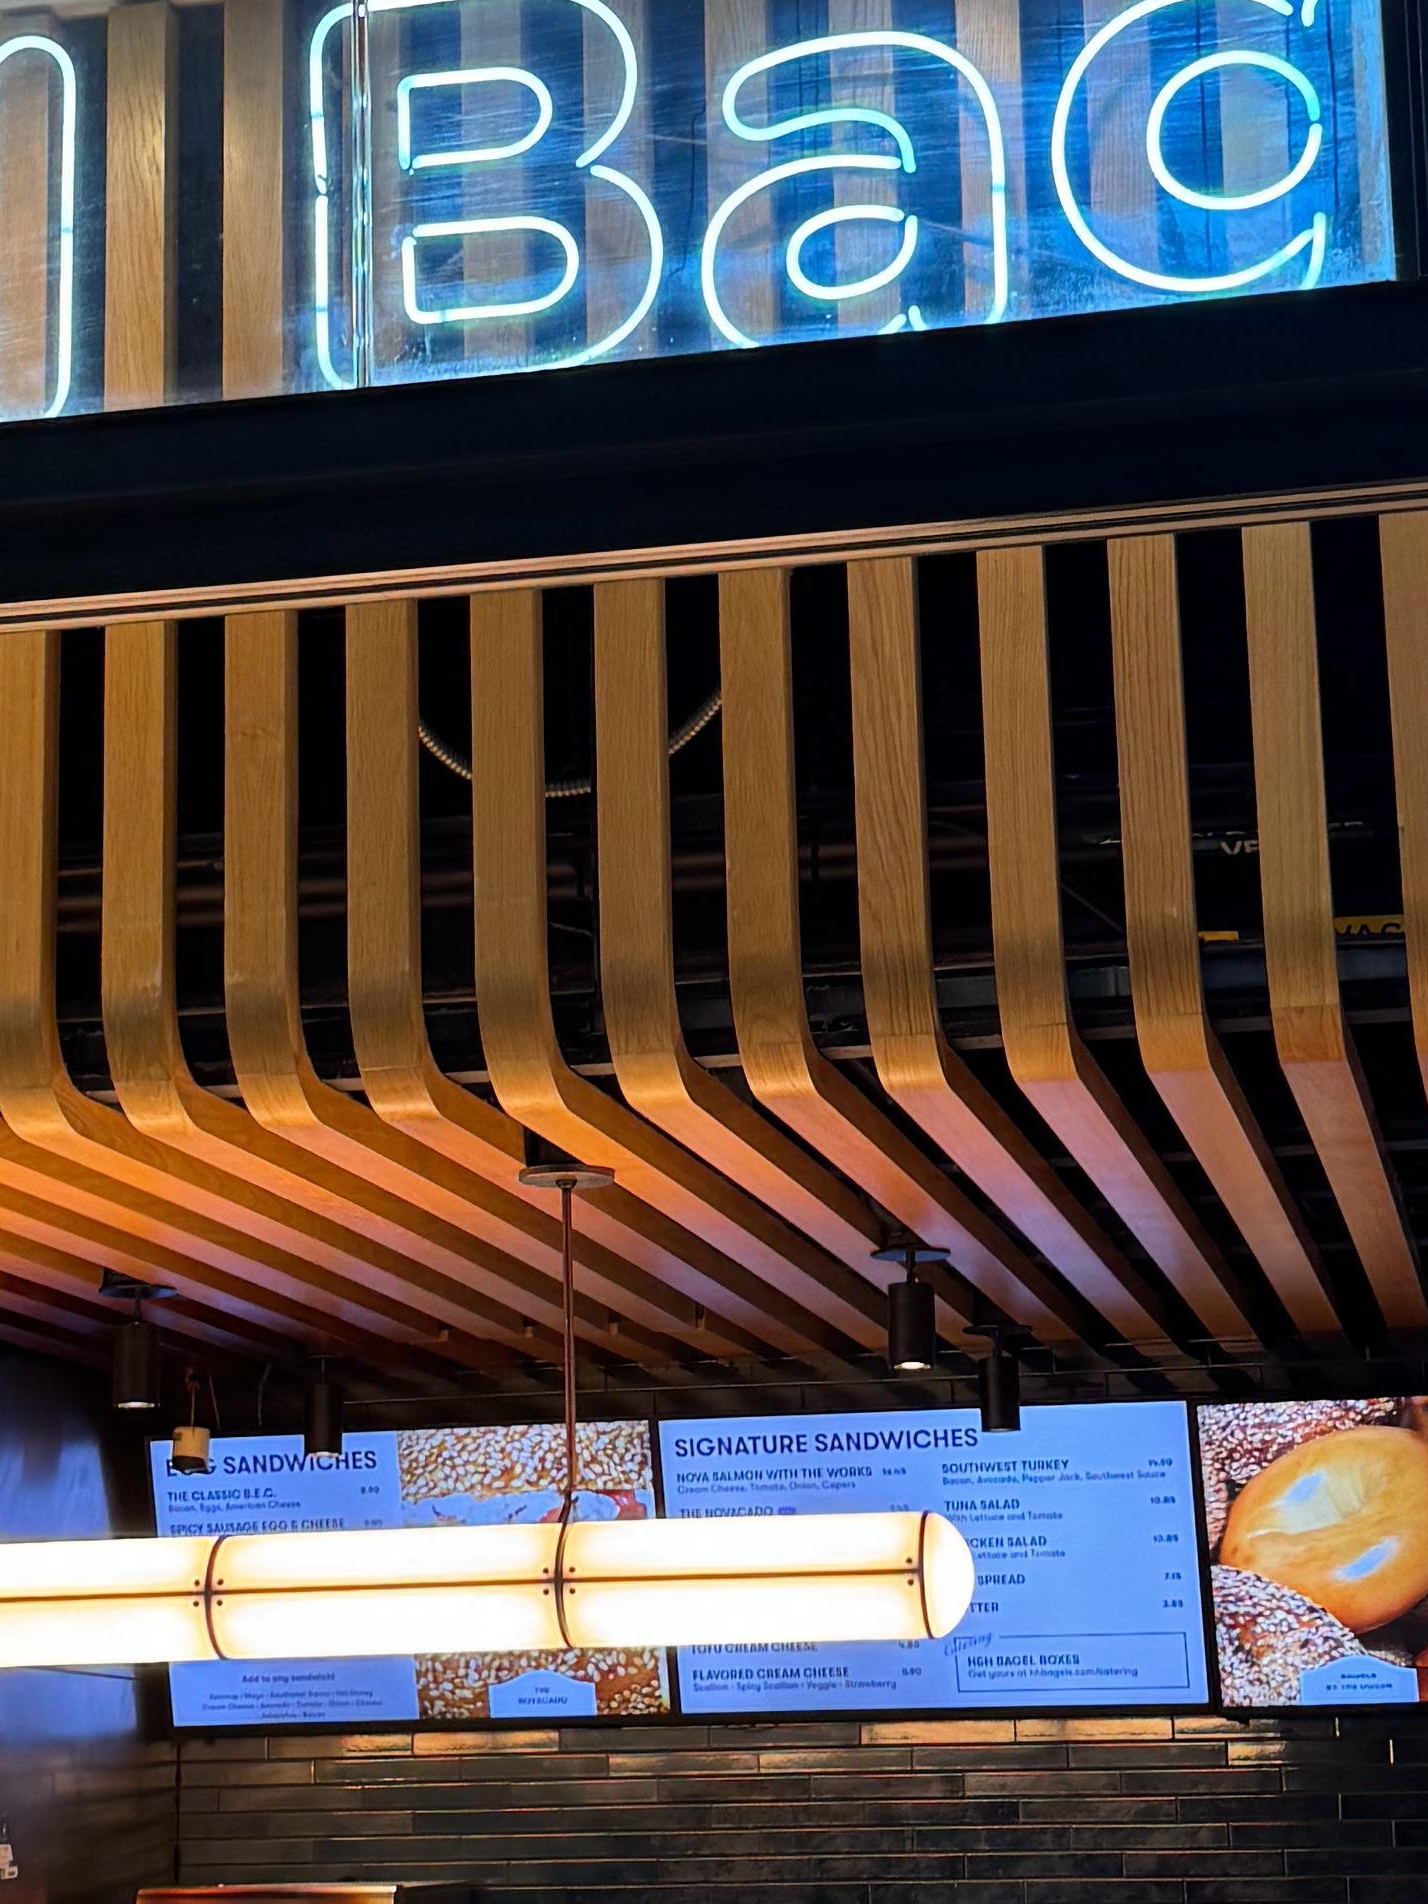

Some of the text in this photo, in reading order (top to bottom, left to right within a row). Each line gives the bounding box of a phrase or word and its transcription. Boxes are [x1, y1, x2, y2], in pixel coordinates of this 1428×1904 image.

[674, 1428, 979, 1457] SIGNATURE SANDWICHES
[223, 1451, 377, 1475] SANDWICHES
[942, 1459, 1068, 1473] SOUTHWEST TURKEY
[766, 1469, 798, 1479] WITH
[802, 1468, 821, 1478] THE
[945, 1499, 1020, 1511] TUNA SALAD
[1008, 1536, 1047, 1547] SALAD
[978, 1574, 1025, 1585] SPREAD
[693, 1667, 849, 1680] FLAVORED CREAM CHEESE
